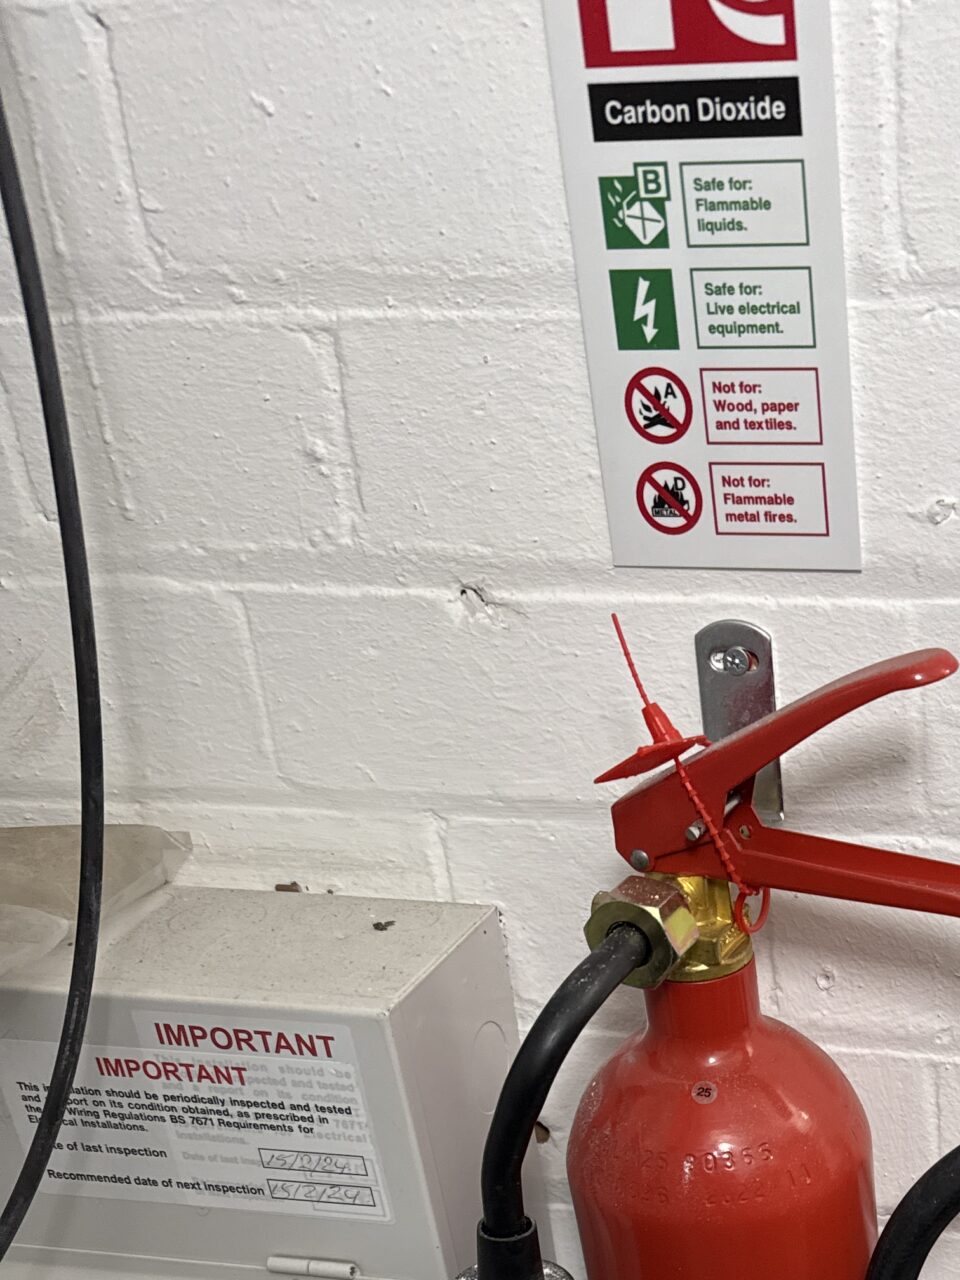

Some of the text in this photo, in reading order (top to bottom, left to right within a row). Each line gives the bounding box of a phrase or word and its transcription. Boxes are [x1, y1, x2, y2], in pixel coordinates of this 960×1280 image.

[604, 95, 787, 125] Carbon Dioxide
[641, 169, 663, 196] B
[693, 176, 753, 192] Safe for:
[695, 196, 772, 212] Flammable
[697, 217, 749, 235] liquids.
[704, 281, 763, 297] Safe for:
[706, 300, 801, 315] Live electrical
[708, 321, 784, 338] equipment.
[663, 382, 678, 399] A
[712, 380, 762, 394] Not for:
[712, 399, 800, 416] Wood, paper
[715, 417, 797, 431] and textiles.
[673, 476, 686, 492] D
[721, 475, 771, 488] Not for:
[722, 493, 795, 506] Flammable
[725, 509, 798, 524] metal fires.
[154, 1021, 336, 1058] IMPORTANT
[94, 1056, 248, 1086] IMPORTANT
[16, 1081, 353, 1116] This should be periodically inspected and tested
[21, 1093, 330, 1125] and on its condition obtained, as prescribed in
[66, 1106, 100, 1120] Wiring
[103, 1108, 167, 1124] Regulations
[170, 1116, 187, 1126] BS
[188, 1116, 215, 1127] 7671
[217, 1117, 295, 1133] Requirements
[297, 1123, 315, 1135] for
[81, 1119, 149, 1132] Installations.
[66, 1141, 168, 1159] of last inspection
[47, 1168, 265, 1196] Recommended date of next inspection
